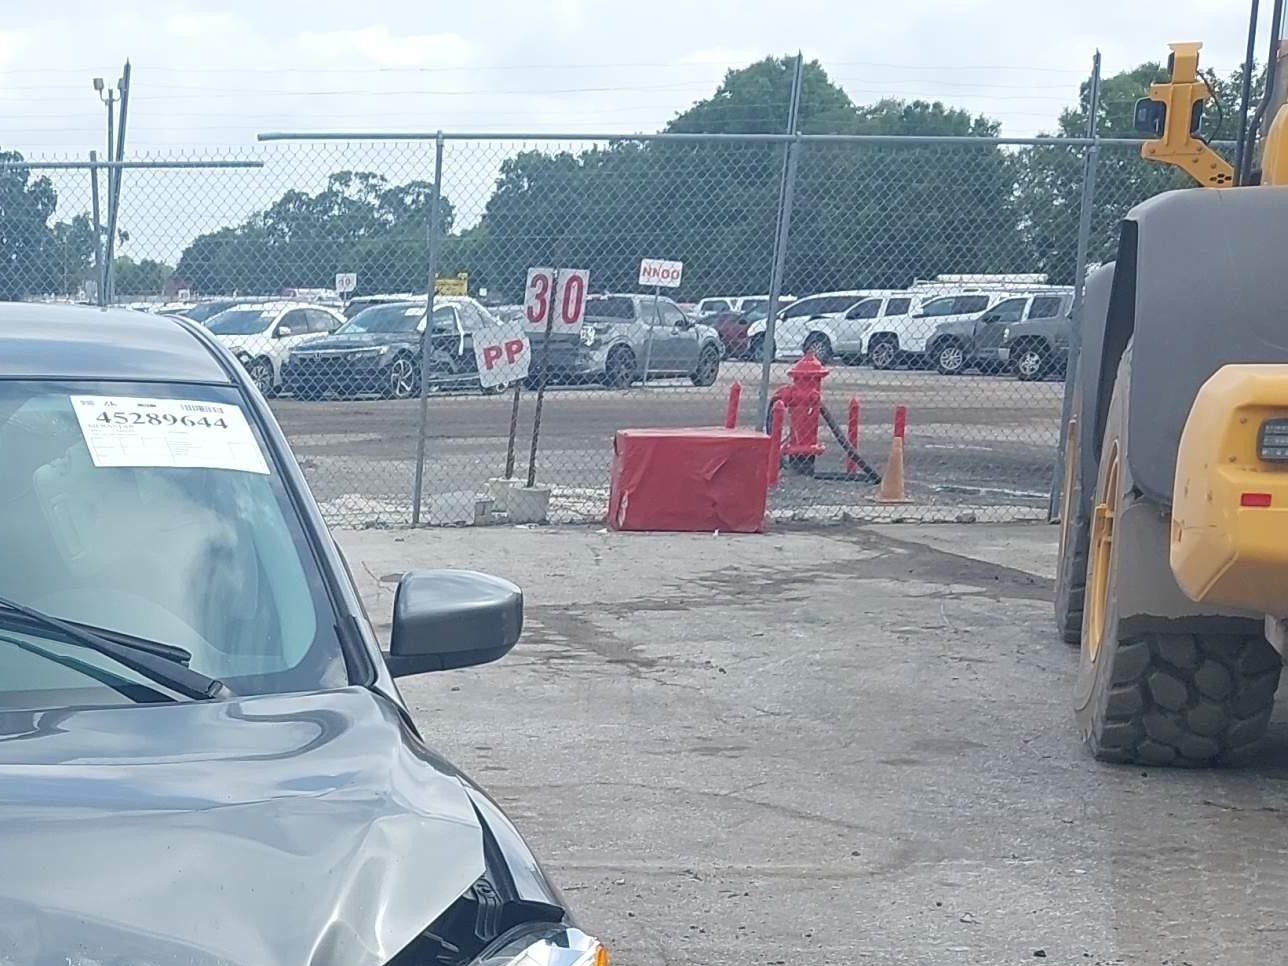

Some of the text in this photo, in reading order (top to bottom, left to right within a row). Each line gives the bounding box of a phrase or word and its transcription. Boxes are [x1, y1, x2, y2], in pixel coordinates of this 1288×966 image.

[641, 265, 680, 280] NNOO
[527, 273, 584, 324] 30
[482, 339, 524, 370] PP
[96, 410, 229, 430] 45289644
